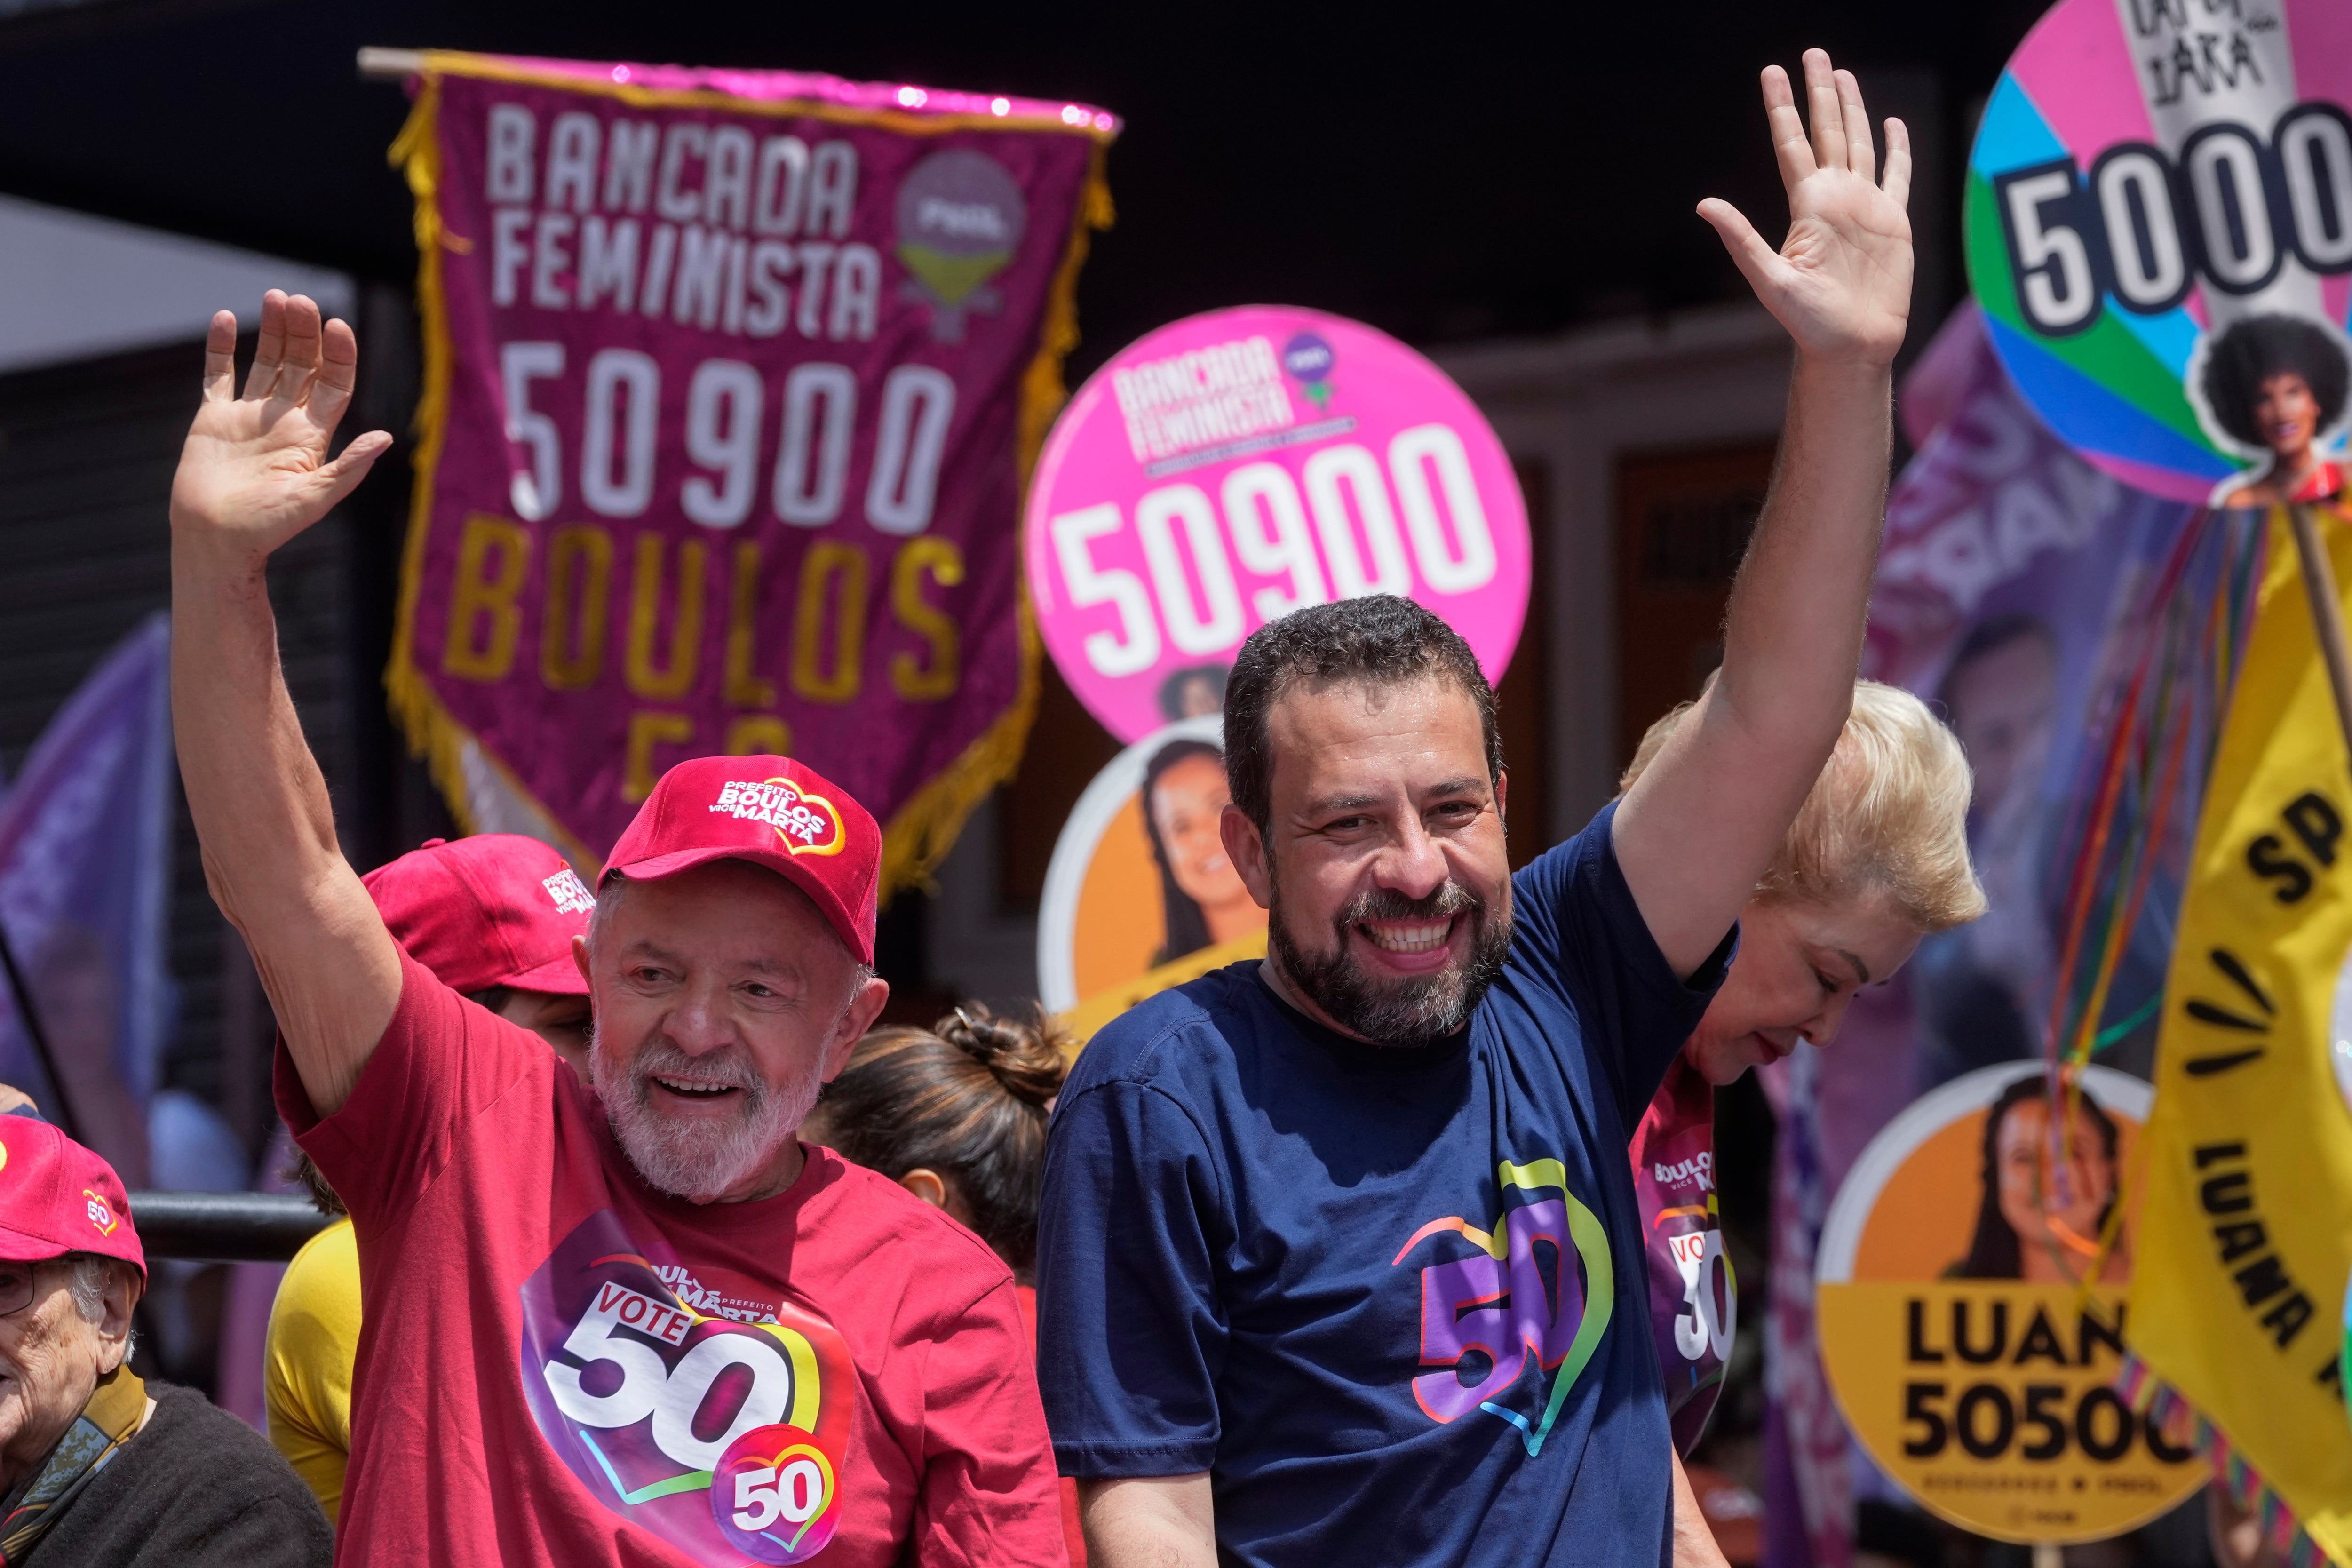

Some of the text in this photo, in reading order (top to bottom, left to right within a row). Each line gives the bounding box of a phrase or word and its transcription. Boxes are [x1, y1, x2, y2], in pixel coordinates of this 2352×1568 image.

[485, 102, 858, 239] BANCADA
[1999, 107, 2352, 332] 5000
[491, 207, 882, 342] FEMINISTA
[501, 342, 955, 534] 50900
[1050, 422, 1498, 677] 50900
[440, 513, 966, 708] BOULOS
[717, 789, 826, 834] BOULOS
[724, 781, 797, 801] PREFEITO
[732, 804, 813, 845] MARTA
[2246, 793, 2342, 903] SP
[87, 1200, 110, 1225] 50
[1655, 1151, 1713, 1183] BOULO
[1670, 1177, 1693, 1190] VICE
[2193, 1139, 2315, 1350] LUANA
[597, 1284, 692, 1343] VOTE
[675, 1283, 782, 1326] MARTA
[722, 1298, 773, 1311] PREFEITO
[1412, 1198, 1585, 1424] 50
[543, 1313, 789, 1471] 50
[732, 1460, 823, 1532] 50
